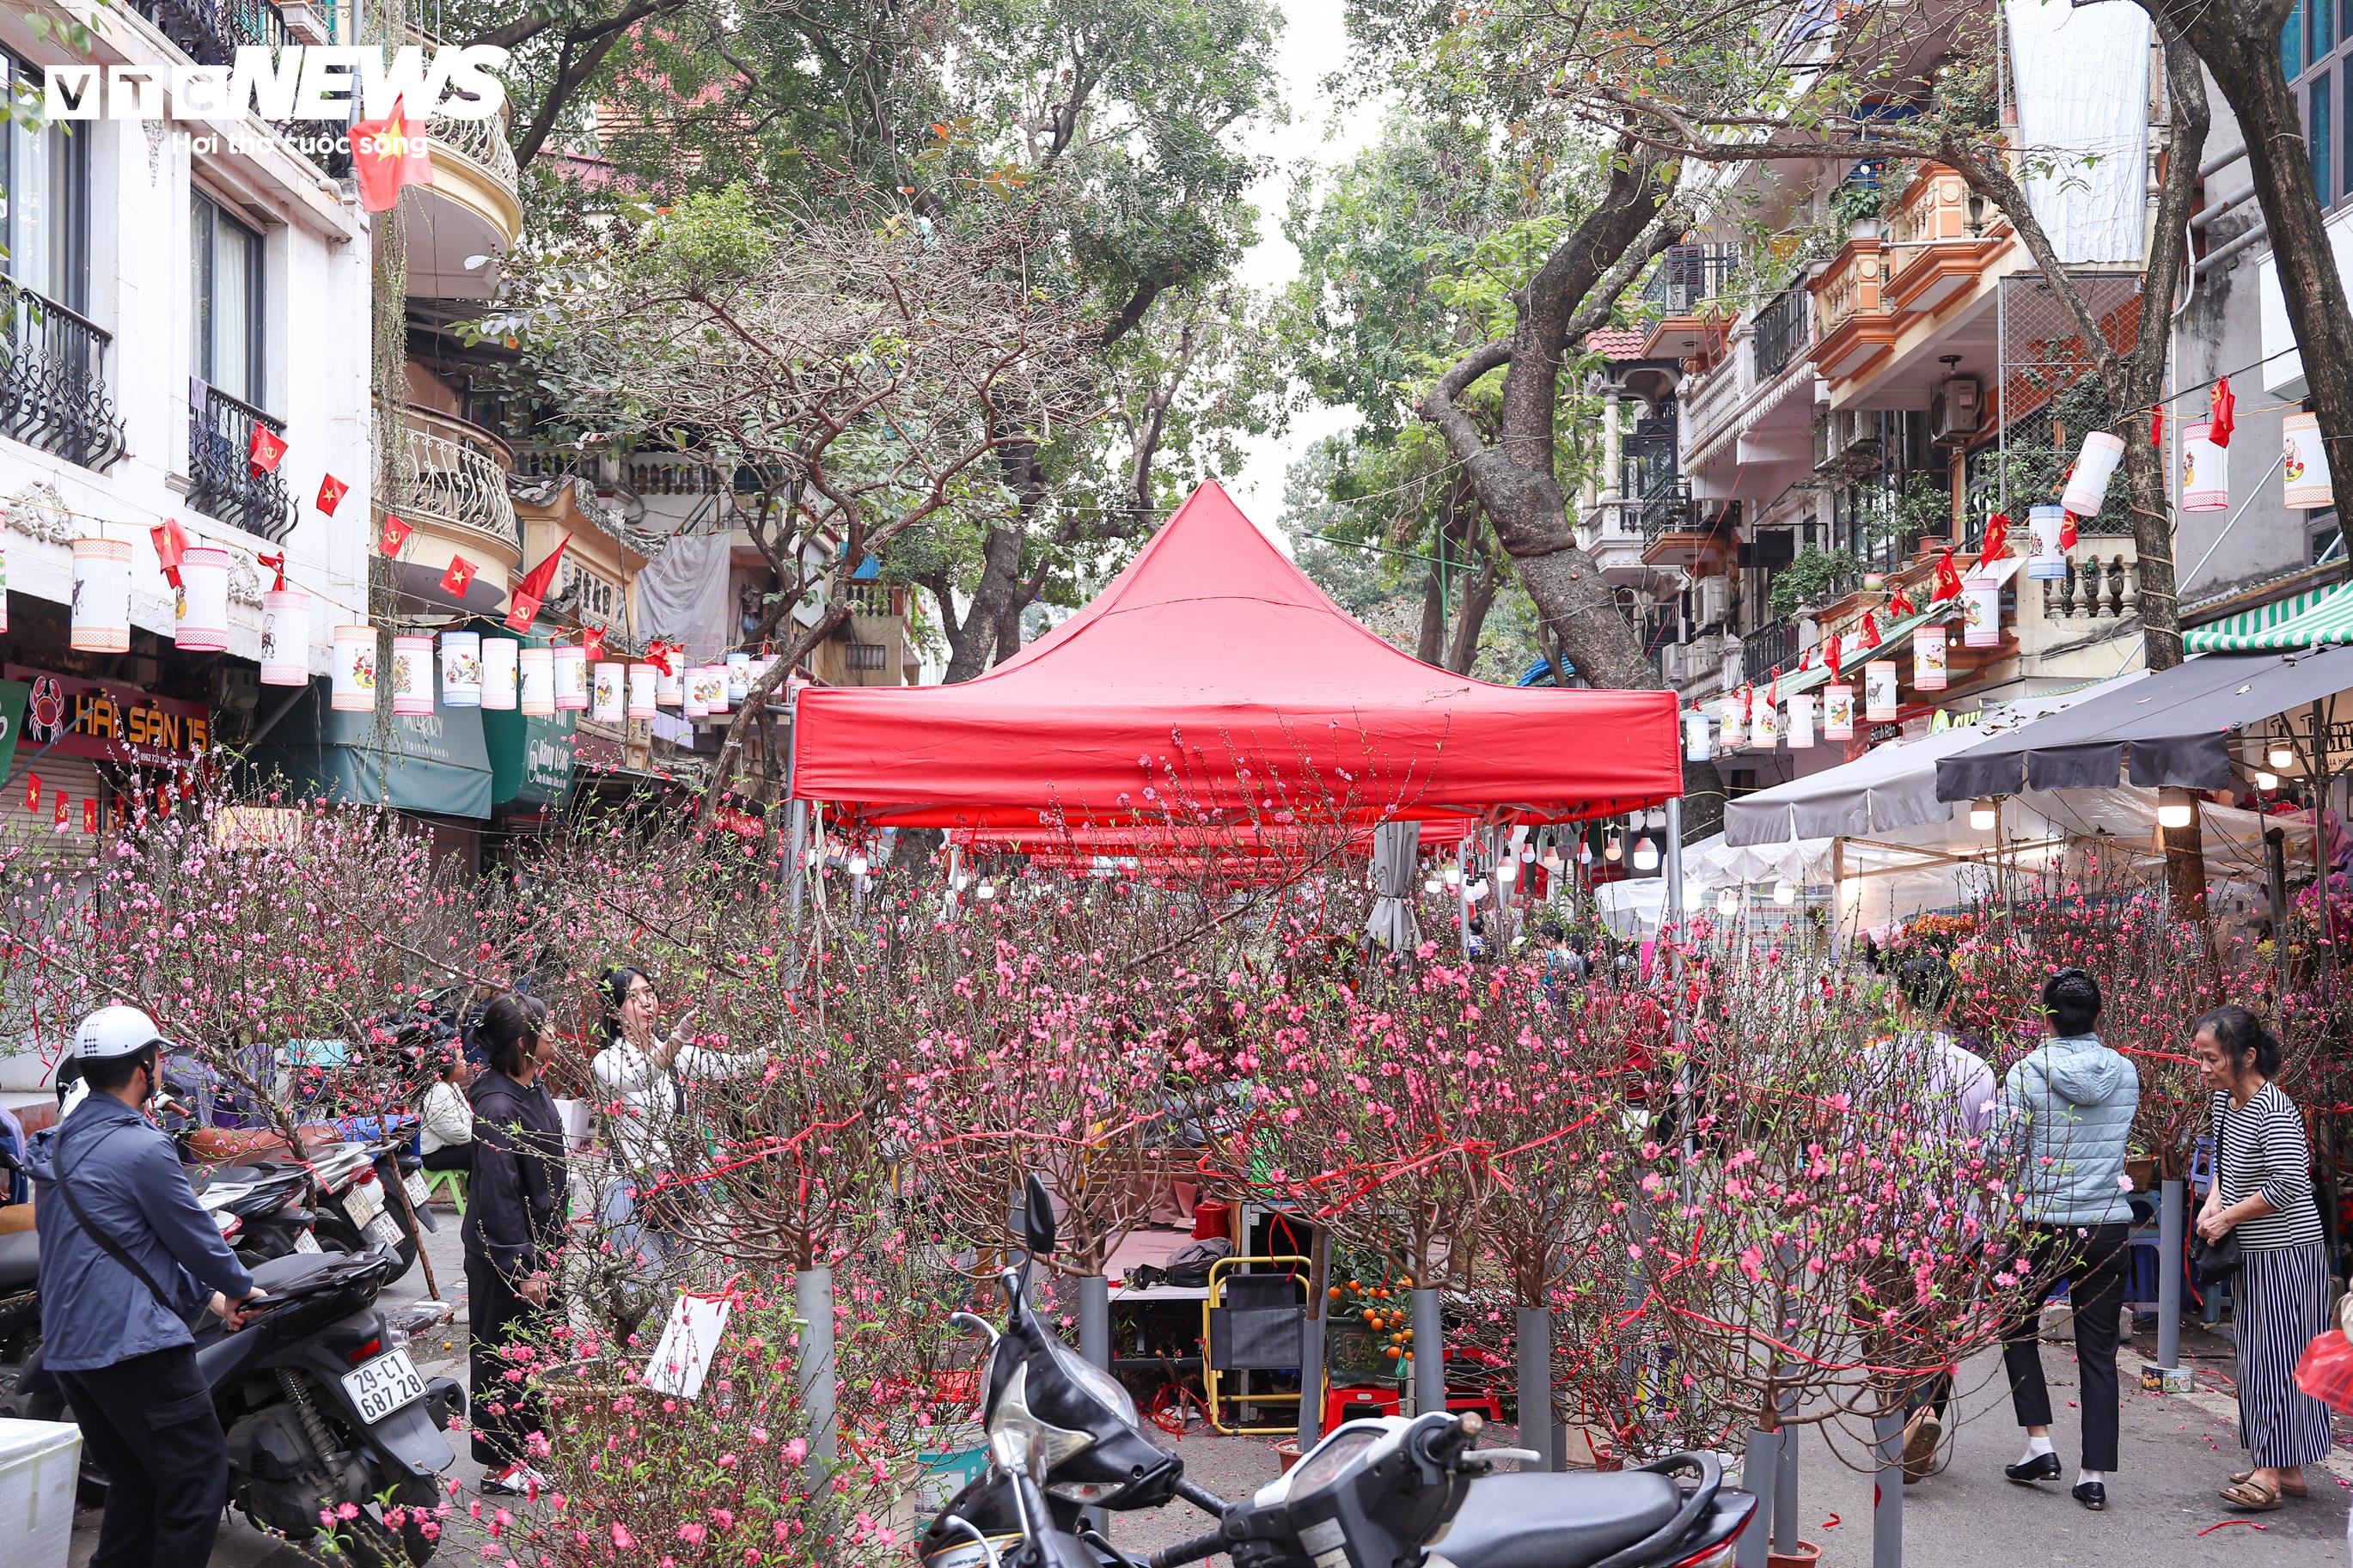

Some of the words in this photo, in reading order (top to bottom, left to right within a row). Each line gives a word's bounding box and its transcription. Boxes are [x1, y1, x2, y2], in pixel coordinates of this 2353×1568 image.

[129, 699, 179, 750] SẢN
[186, 718, 207, 752] 15
[353, 1355, 404, 1394] 29-C1
[361, 1374, 422, 1418] 687.28
